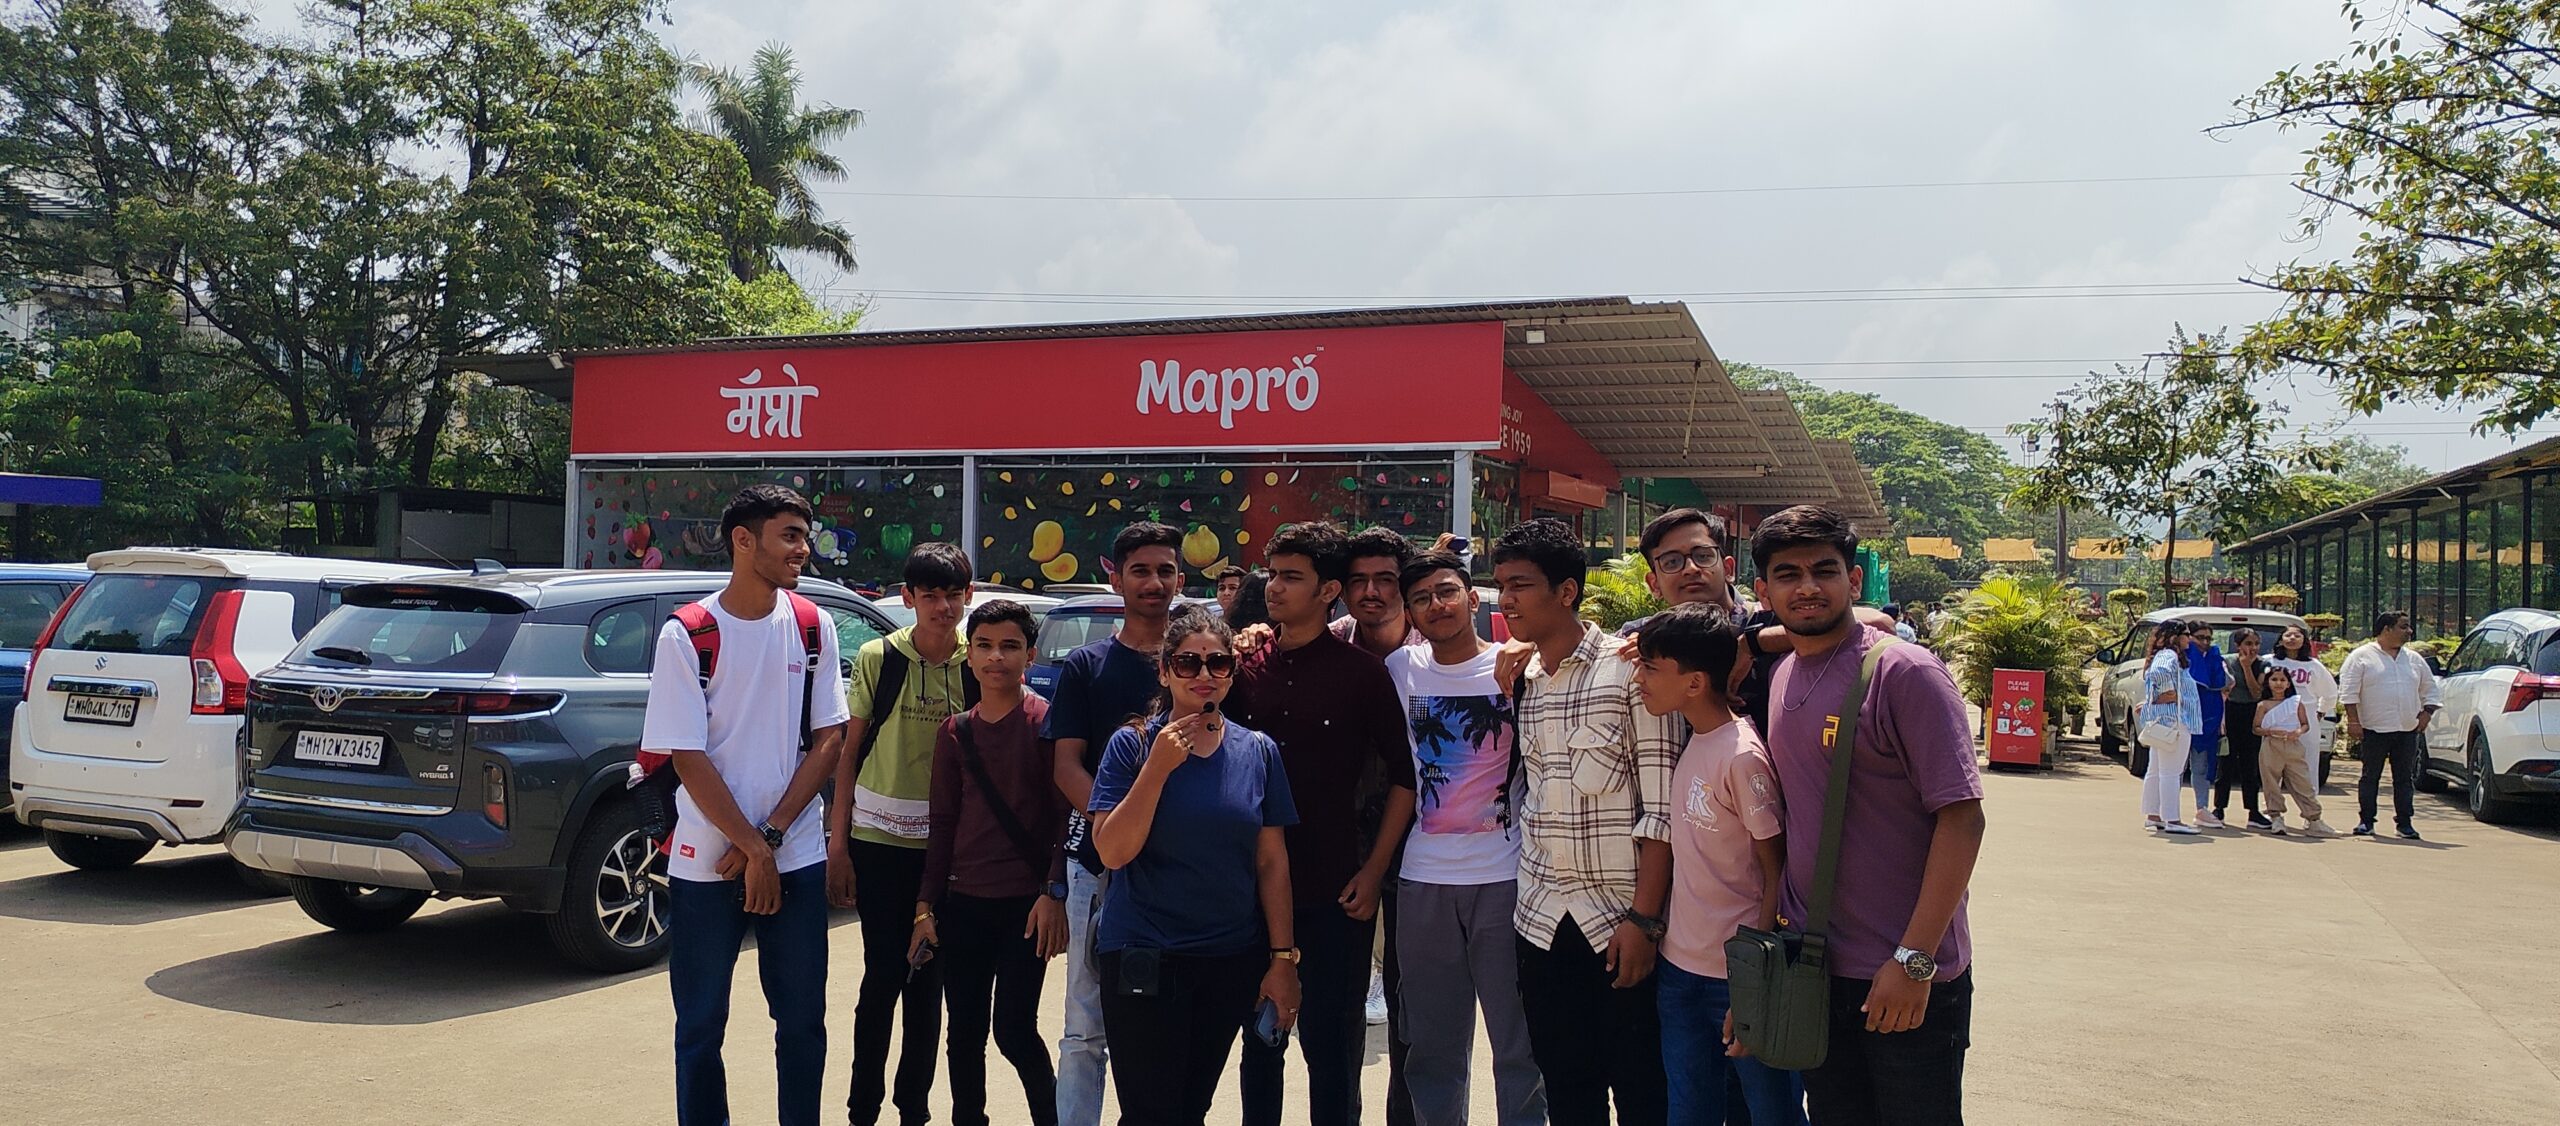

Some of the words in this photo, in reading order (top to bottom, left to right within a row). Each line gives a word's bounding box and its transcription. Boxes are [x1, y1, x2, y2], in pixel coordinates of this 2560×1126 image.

[1136, 354, 1319, 430] Mapro
[1511, 407, 1524, 425] JOY
[1510, 427, 1532, 456] 1959
[75, 698, 132, 719] MH04KL7116
[305, 735, 381, 760] MH12WZ3452
[871, 808, 929, 833] AUTHEN
